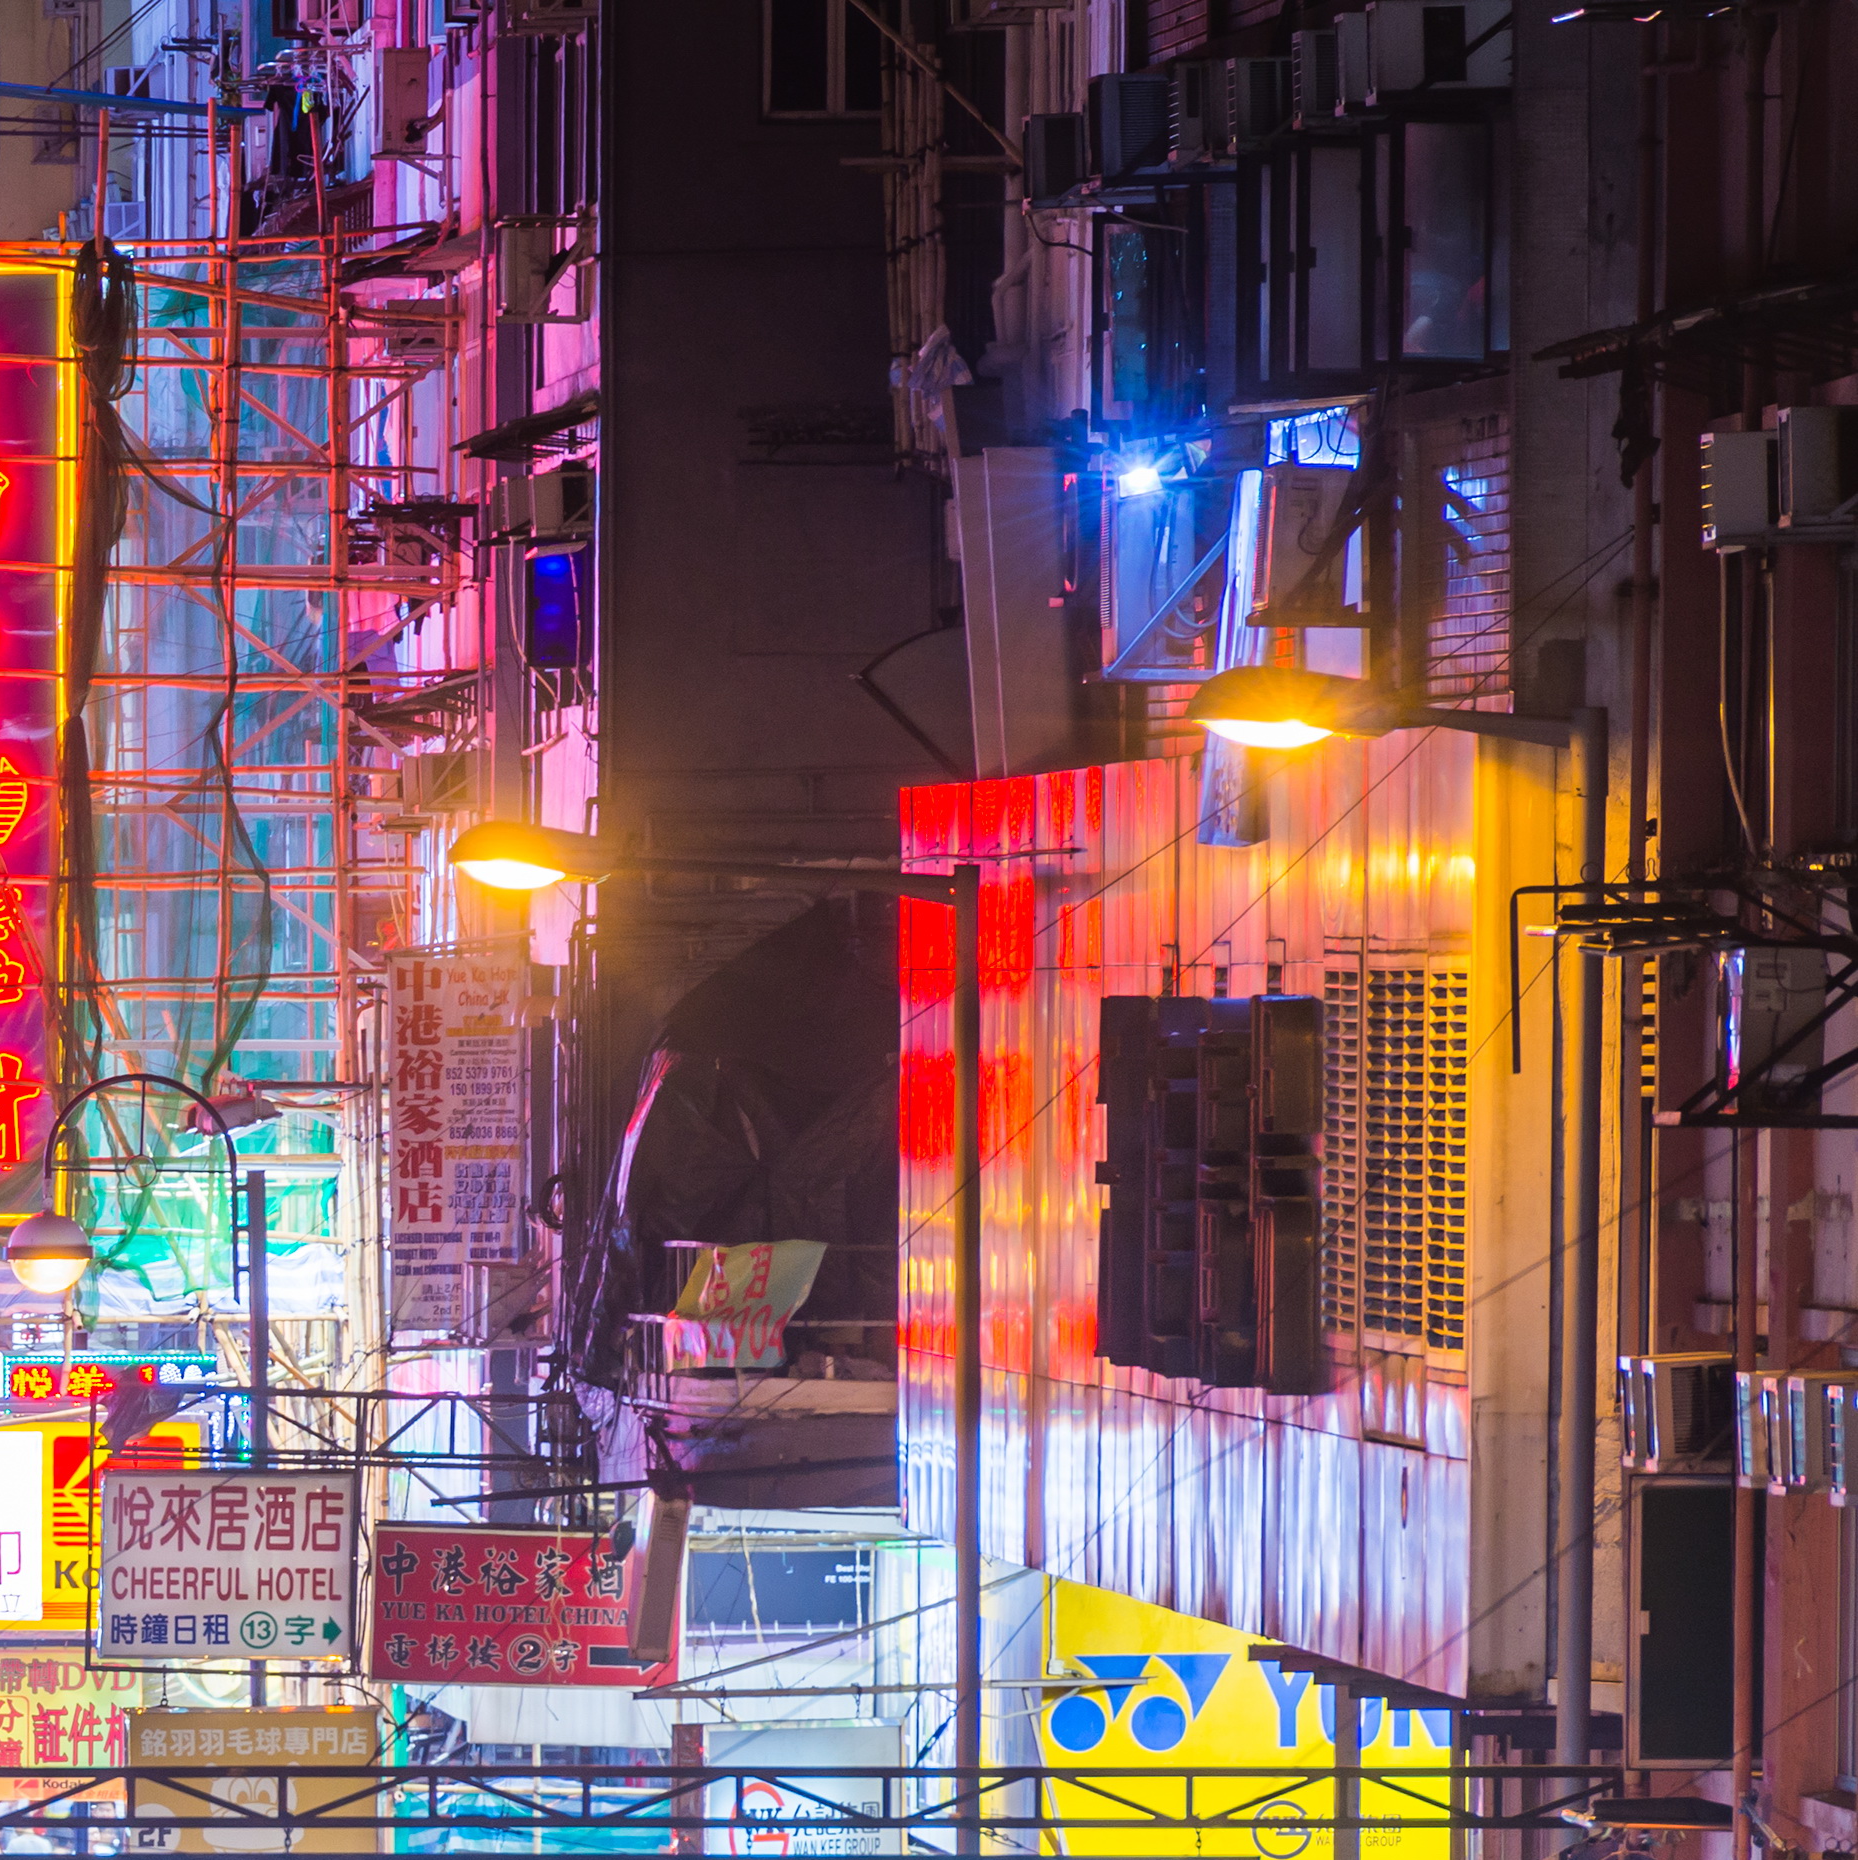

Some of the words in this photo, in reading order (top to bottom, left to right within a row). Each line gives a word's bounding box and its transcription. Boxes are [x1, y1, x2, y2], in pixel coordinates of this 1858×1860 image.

[396, 961, 443, 1223] 中港裕家酒店
[112, 1484, 344, 1552] 悅來居酒店
[111, 1567, 249, 1601] CHEERFUL
[257, 1567, 342, 1601] HOTEL
[111, 1613, 230, 1645] 時鐘日租
[382, 1601, 426, 1620] YUE
[436, 1603, 467, 1622] KA
[475, 1605, 552, 1625] HOTEL
[560, 1607, 628, 1627] CHINA
[140, 1727, 368, 1758] 銘羽羽毛球專門店
[138, 1826, 172, 1847] 2F
[793, 1840, 817, 1856] WAN
[844, 1837, 881, 1856] GROUP
[1365, 1835, 1402, 1847] GROUP
